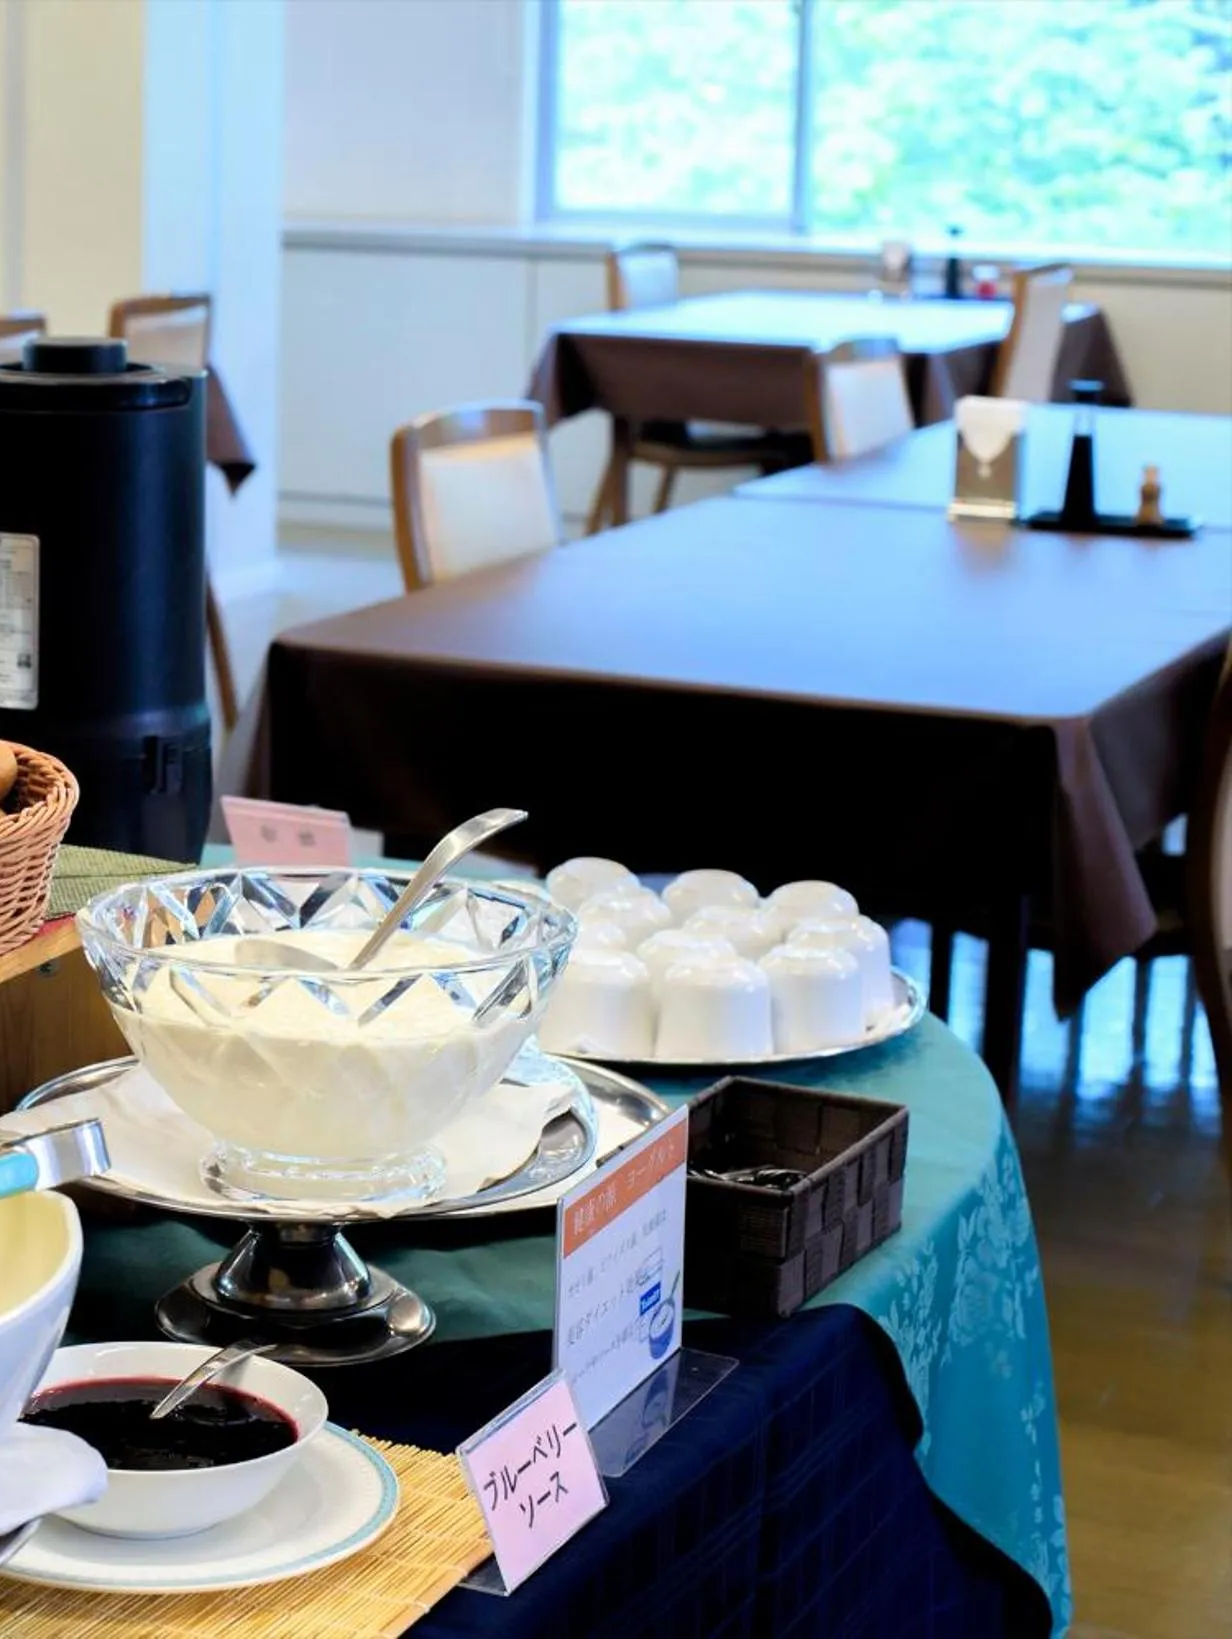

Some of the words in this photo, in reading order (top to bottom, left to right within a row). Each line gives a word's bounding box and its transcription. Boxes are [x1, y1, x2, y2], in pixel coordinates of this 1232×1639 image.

[484, 1422, 577, 1511] ブルーベリー
[519, 1471, 568, 1528] ソース
